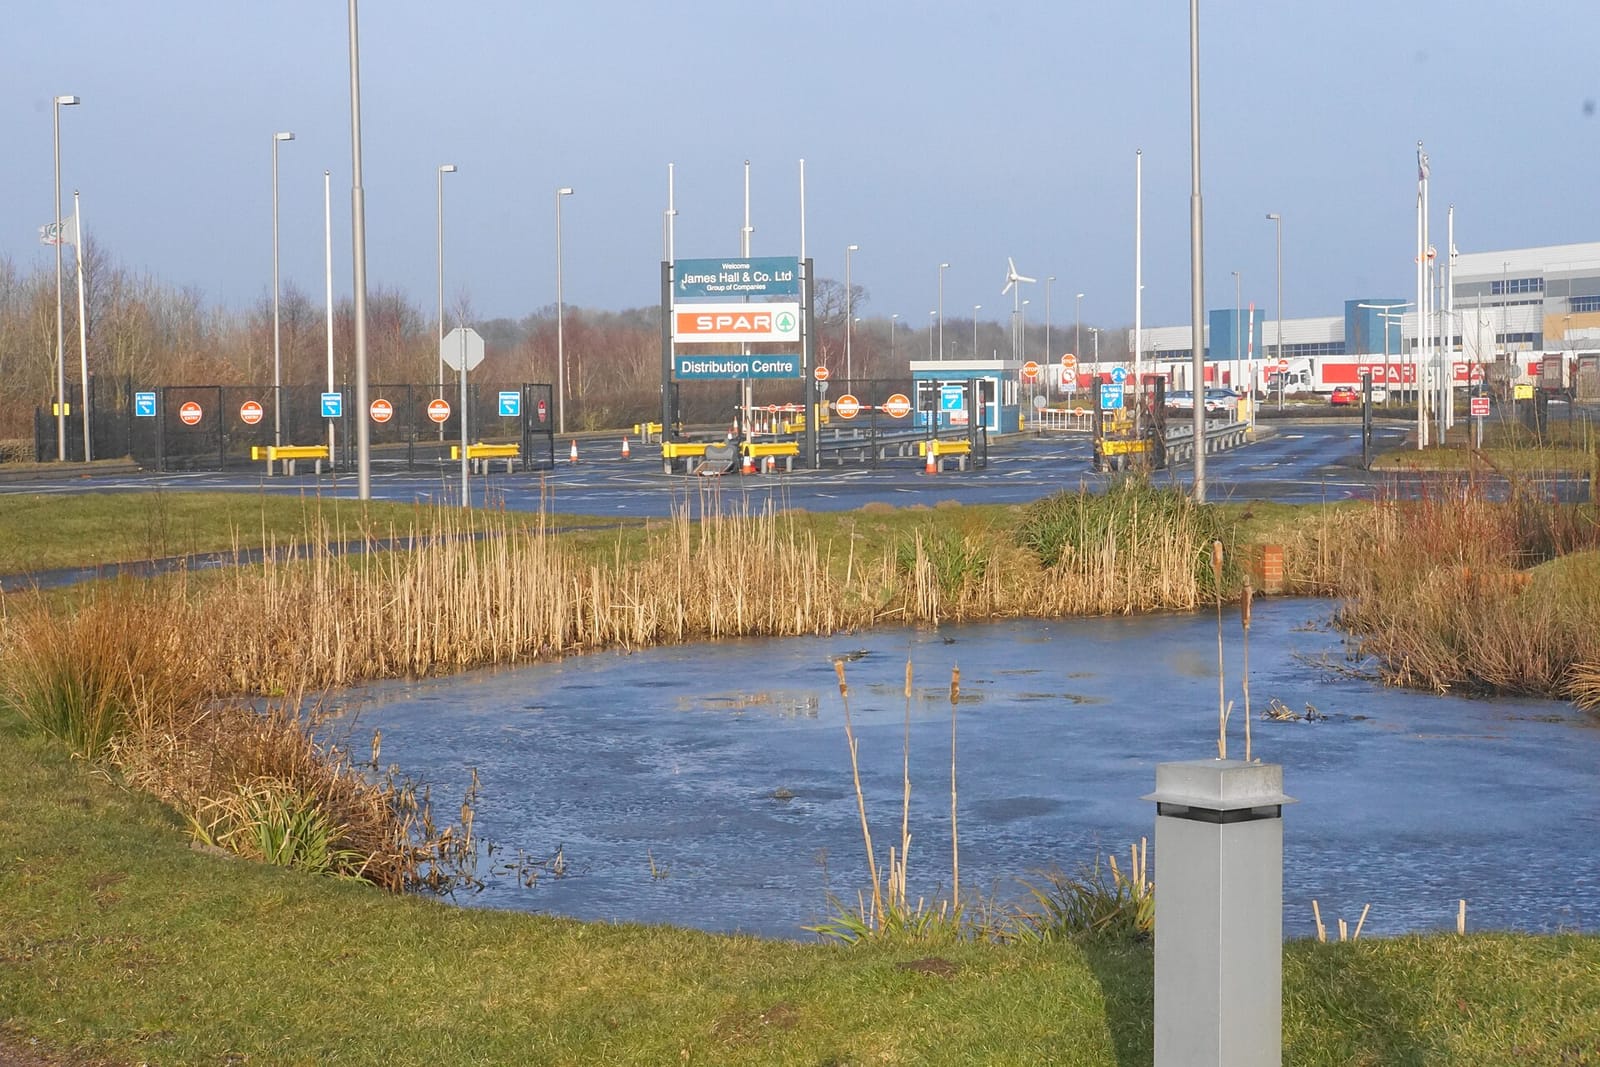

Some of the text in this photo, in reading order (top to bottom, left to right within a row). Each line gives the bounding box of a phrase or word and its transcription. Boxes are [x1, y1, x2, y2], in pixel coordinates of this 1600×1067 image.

[681, 270, 792, 284] James Hall & Co. Ltd
[696, 316, 770, 330] SPAR
[681, 360, 792, 373] Distribution Centre
